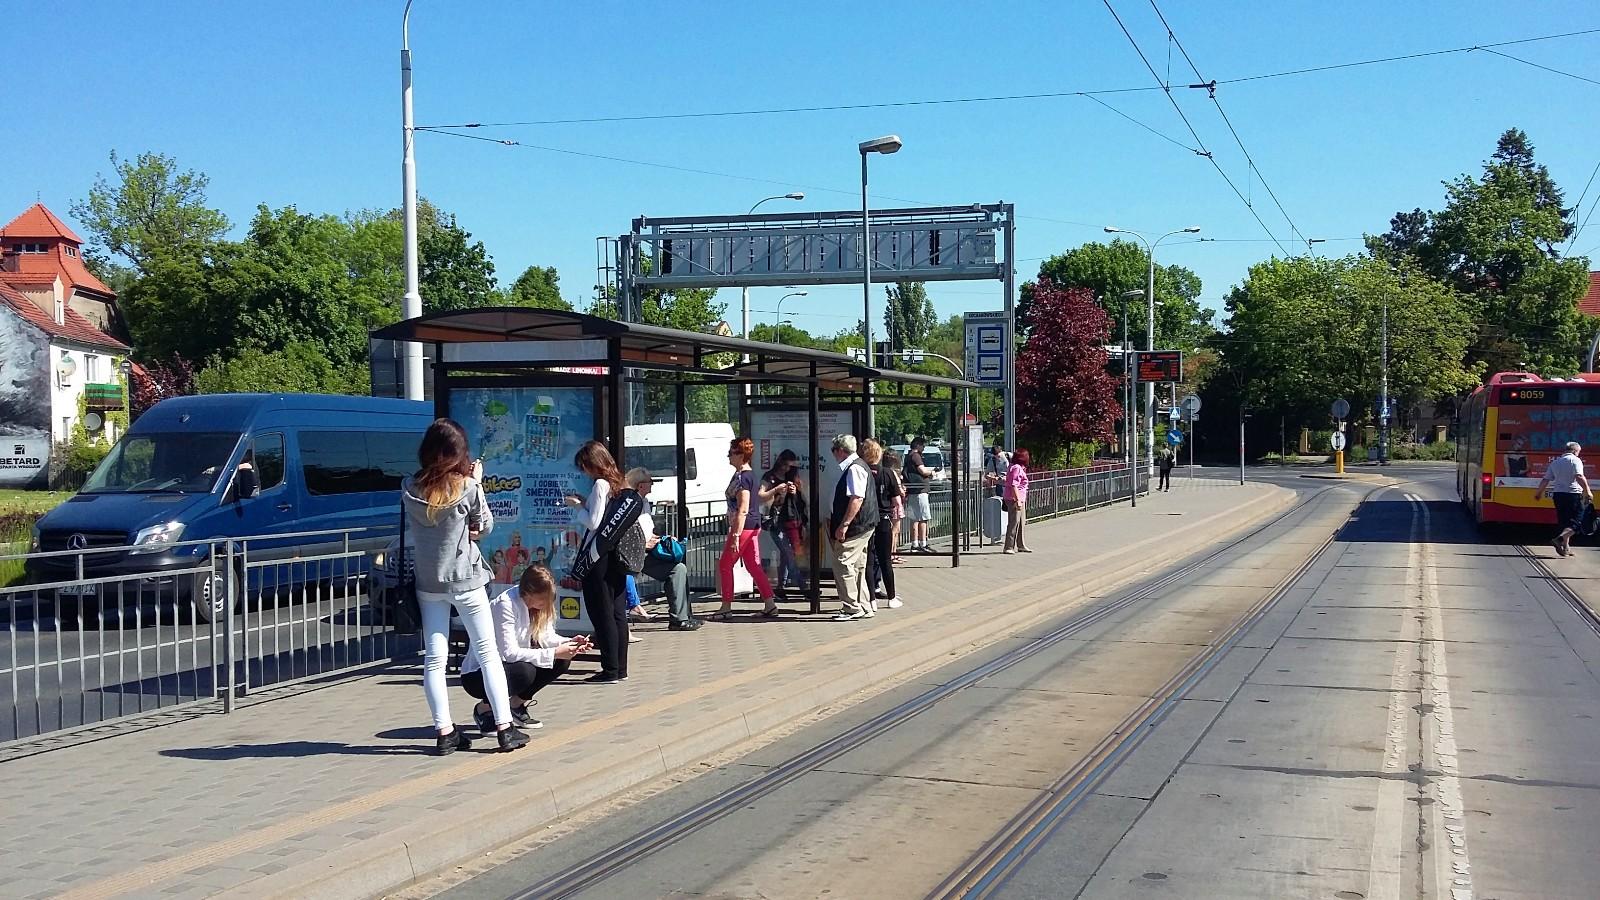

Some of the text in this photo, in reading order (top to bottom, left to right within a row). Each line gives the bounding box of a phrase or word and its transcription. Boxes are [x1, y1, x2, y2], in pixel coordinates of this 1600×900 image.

[1520, 391, 1544, 399] 8059
[538, 480, 569, 488] ODBIERZ
[601, 525, 613, 538] FZ
[610, 497, 634, 526] FORZA
